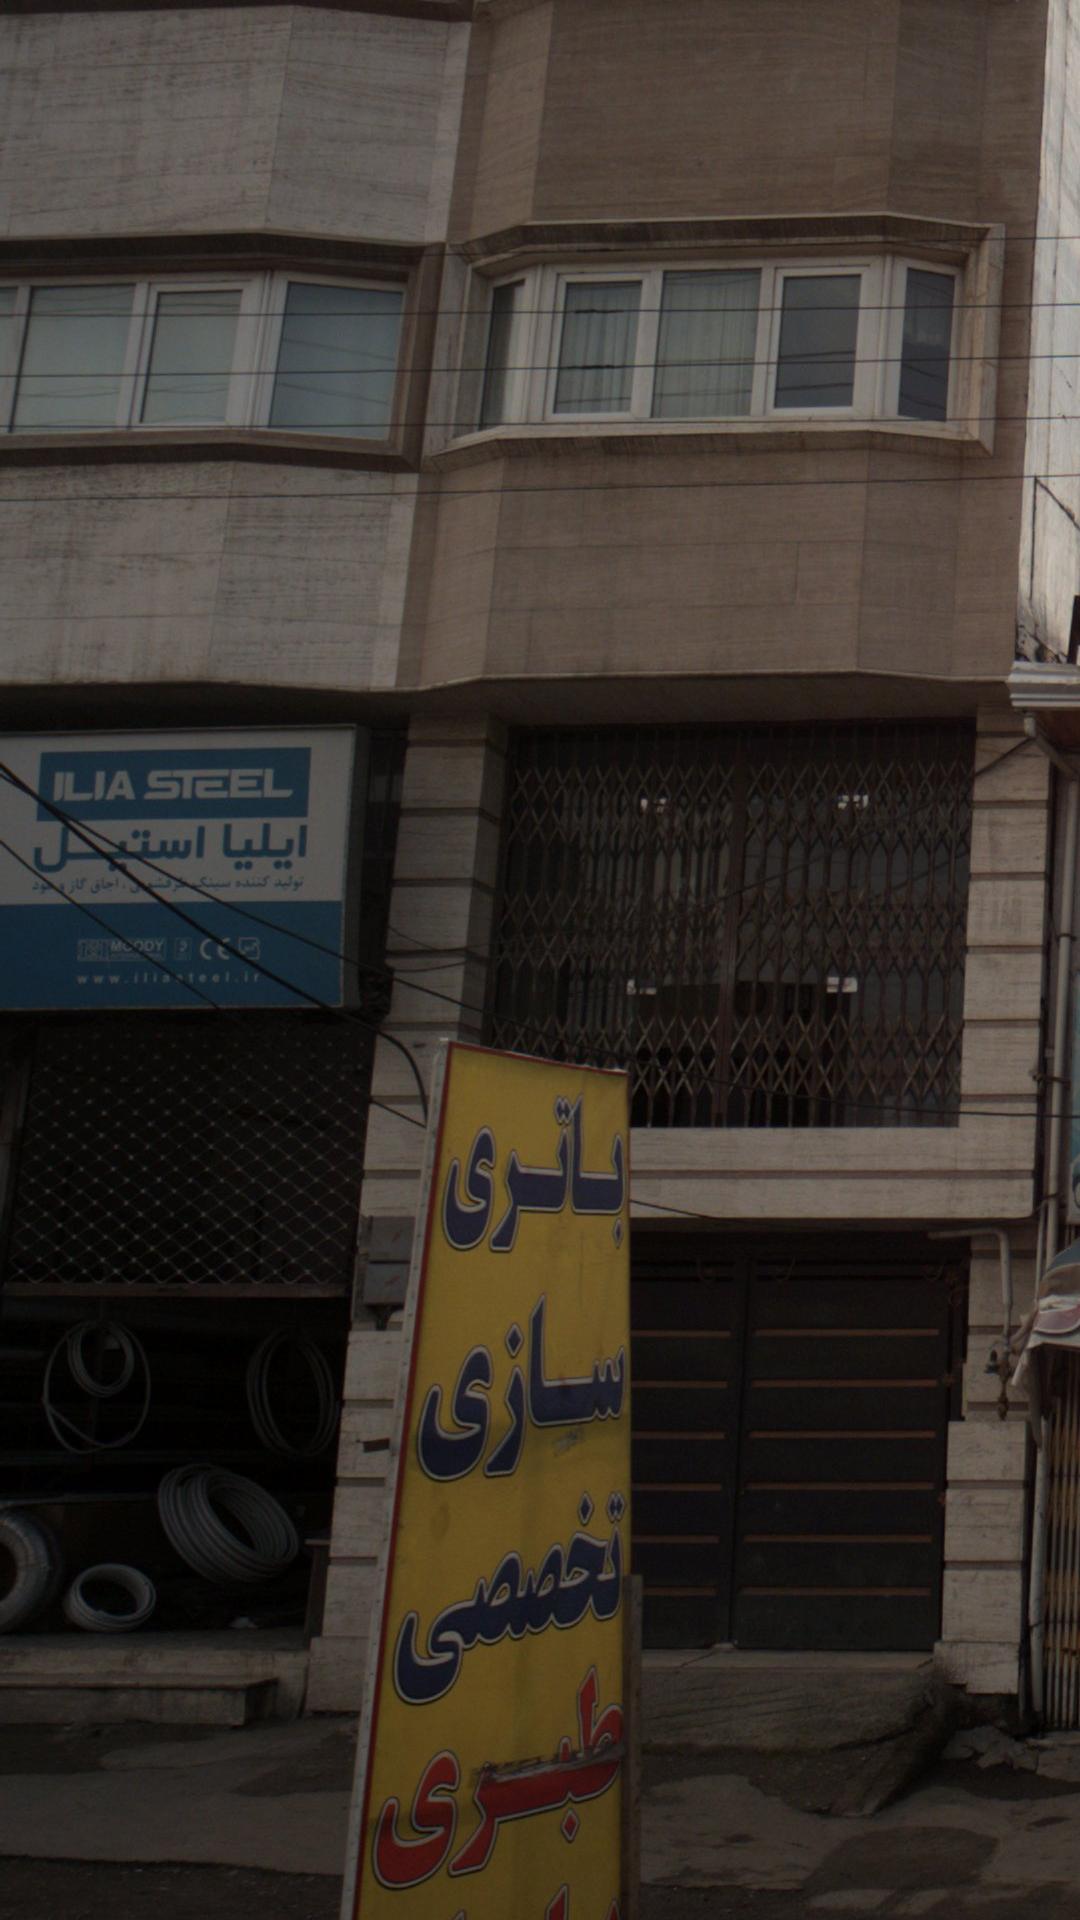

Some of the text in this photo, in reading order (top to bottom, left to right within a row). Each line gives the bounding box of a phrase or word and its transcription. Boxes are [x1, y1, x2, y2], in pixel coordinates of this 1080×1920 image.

[53, 768, 294, 801] ILIA STEEL
[34, 823, 308, 873] ایلیا استیل
[235, 875, 270, 888] کننده
[273, 875, 304, 891] تولید
[443, 1094, 627, 1253] باتری
[418, 1293, 627, 1481] سازی
[394, 1491, 627, 1704] تخصصی
[373, 1665, 627, 1889] طبری
